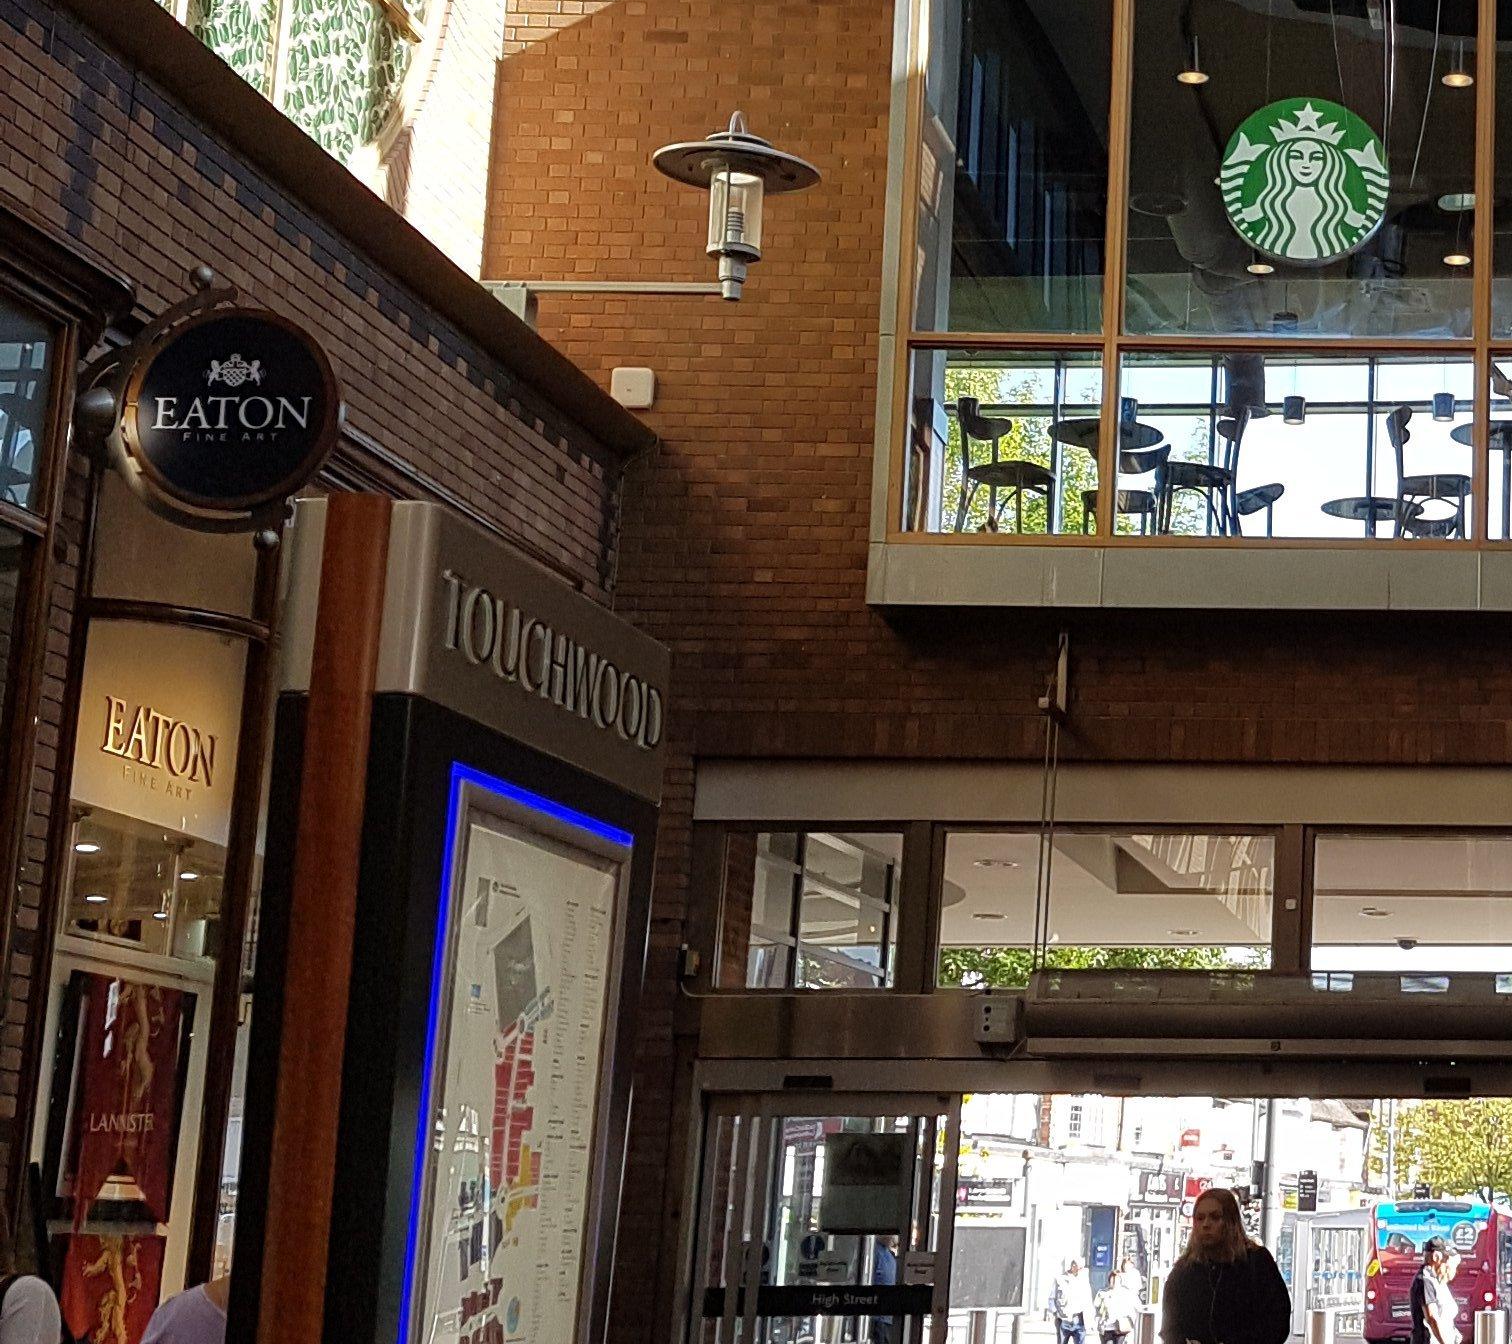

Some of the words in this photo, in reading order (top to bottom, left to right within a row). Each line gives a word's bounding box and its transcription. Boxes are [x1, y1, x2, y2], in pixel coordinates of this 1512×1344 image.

[151, 396, 313, 430] EATON
[441, 568, 662, 751] TOUCHWOOD
[101, 695, 218, 787] EATON
[812, 1293, 840, 1308] High
[843, 1293, 878, 1305] Street
